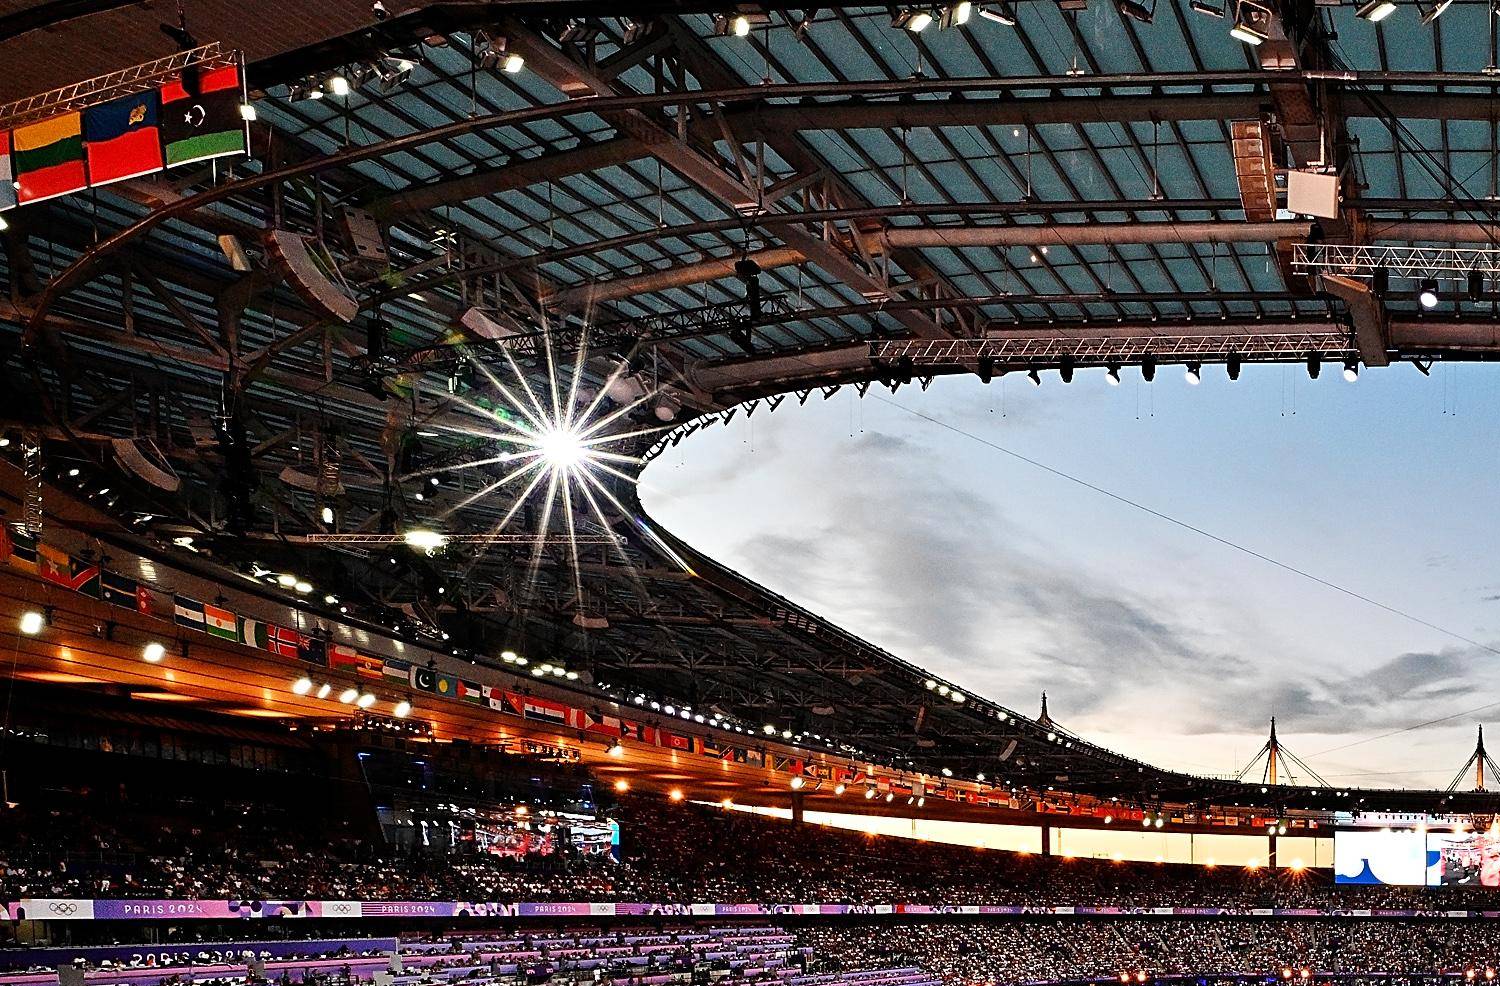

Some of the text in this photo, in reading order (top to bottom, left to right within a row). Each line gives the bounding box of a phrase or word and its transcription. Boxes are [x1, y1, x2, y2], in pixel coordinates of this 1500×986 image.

[125, 904, 164, 914] PARIS
[382, 905, 435, 913] PARIS 2024
